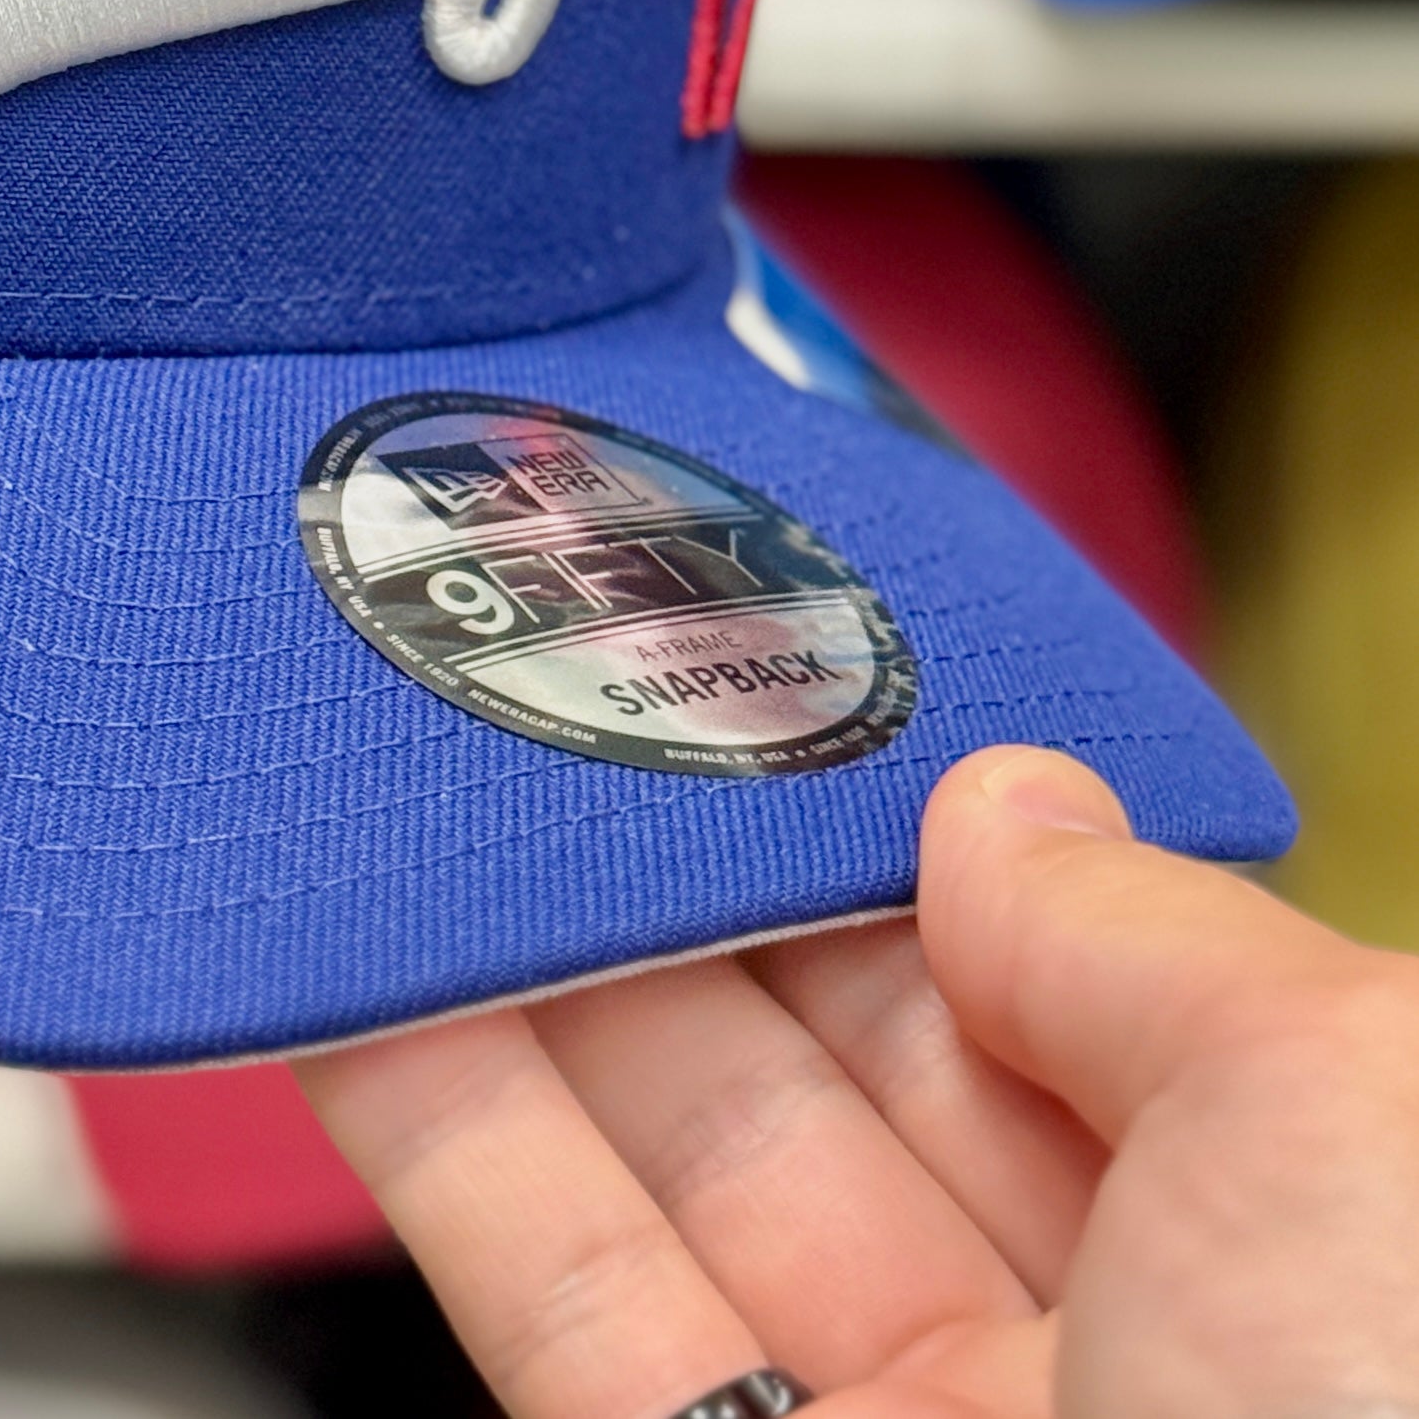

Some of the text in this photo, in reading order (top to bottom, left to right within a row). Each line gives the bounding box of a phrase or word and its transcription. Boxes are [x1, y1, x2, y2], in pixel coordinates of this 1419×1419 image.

[506, 449, 588, 476] NEW
[532, 469, 613, 498] ERA
[425, 528, 764, 636] 9FIFTY
[348, 595, 374, 618] USA
[386, 633, 460, 687] SINCE 1920
[634, 630, 744, 663] A-FRAME
[599, 649, 844, 716] SNAPBACK
[466, 688, 597, 745] NEWERACAP.COM
